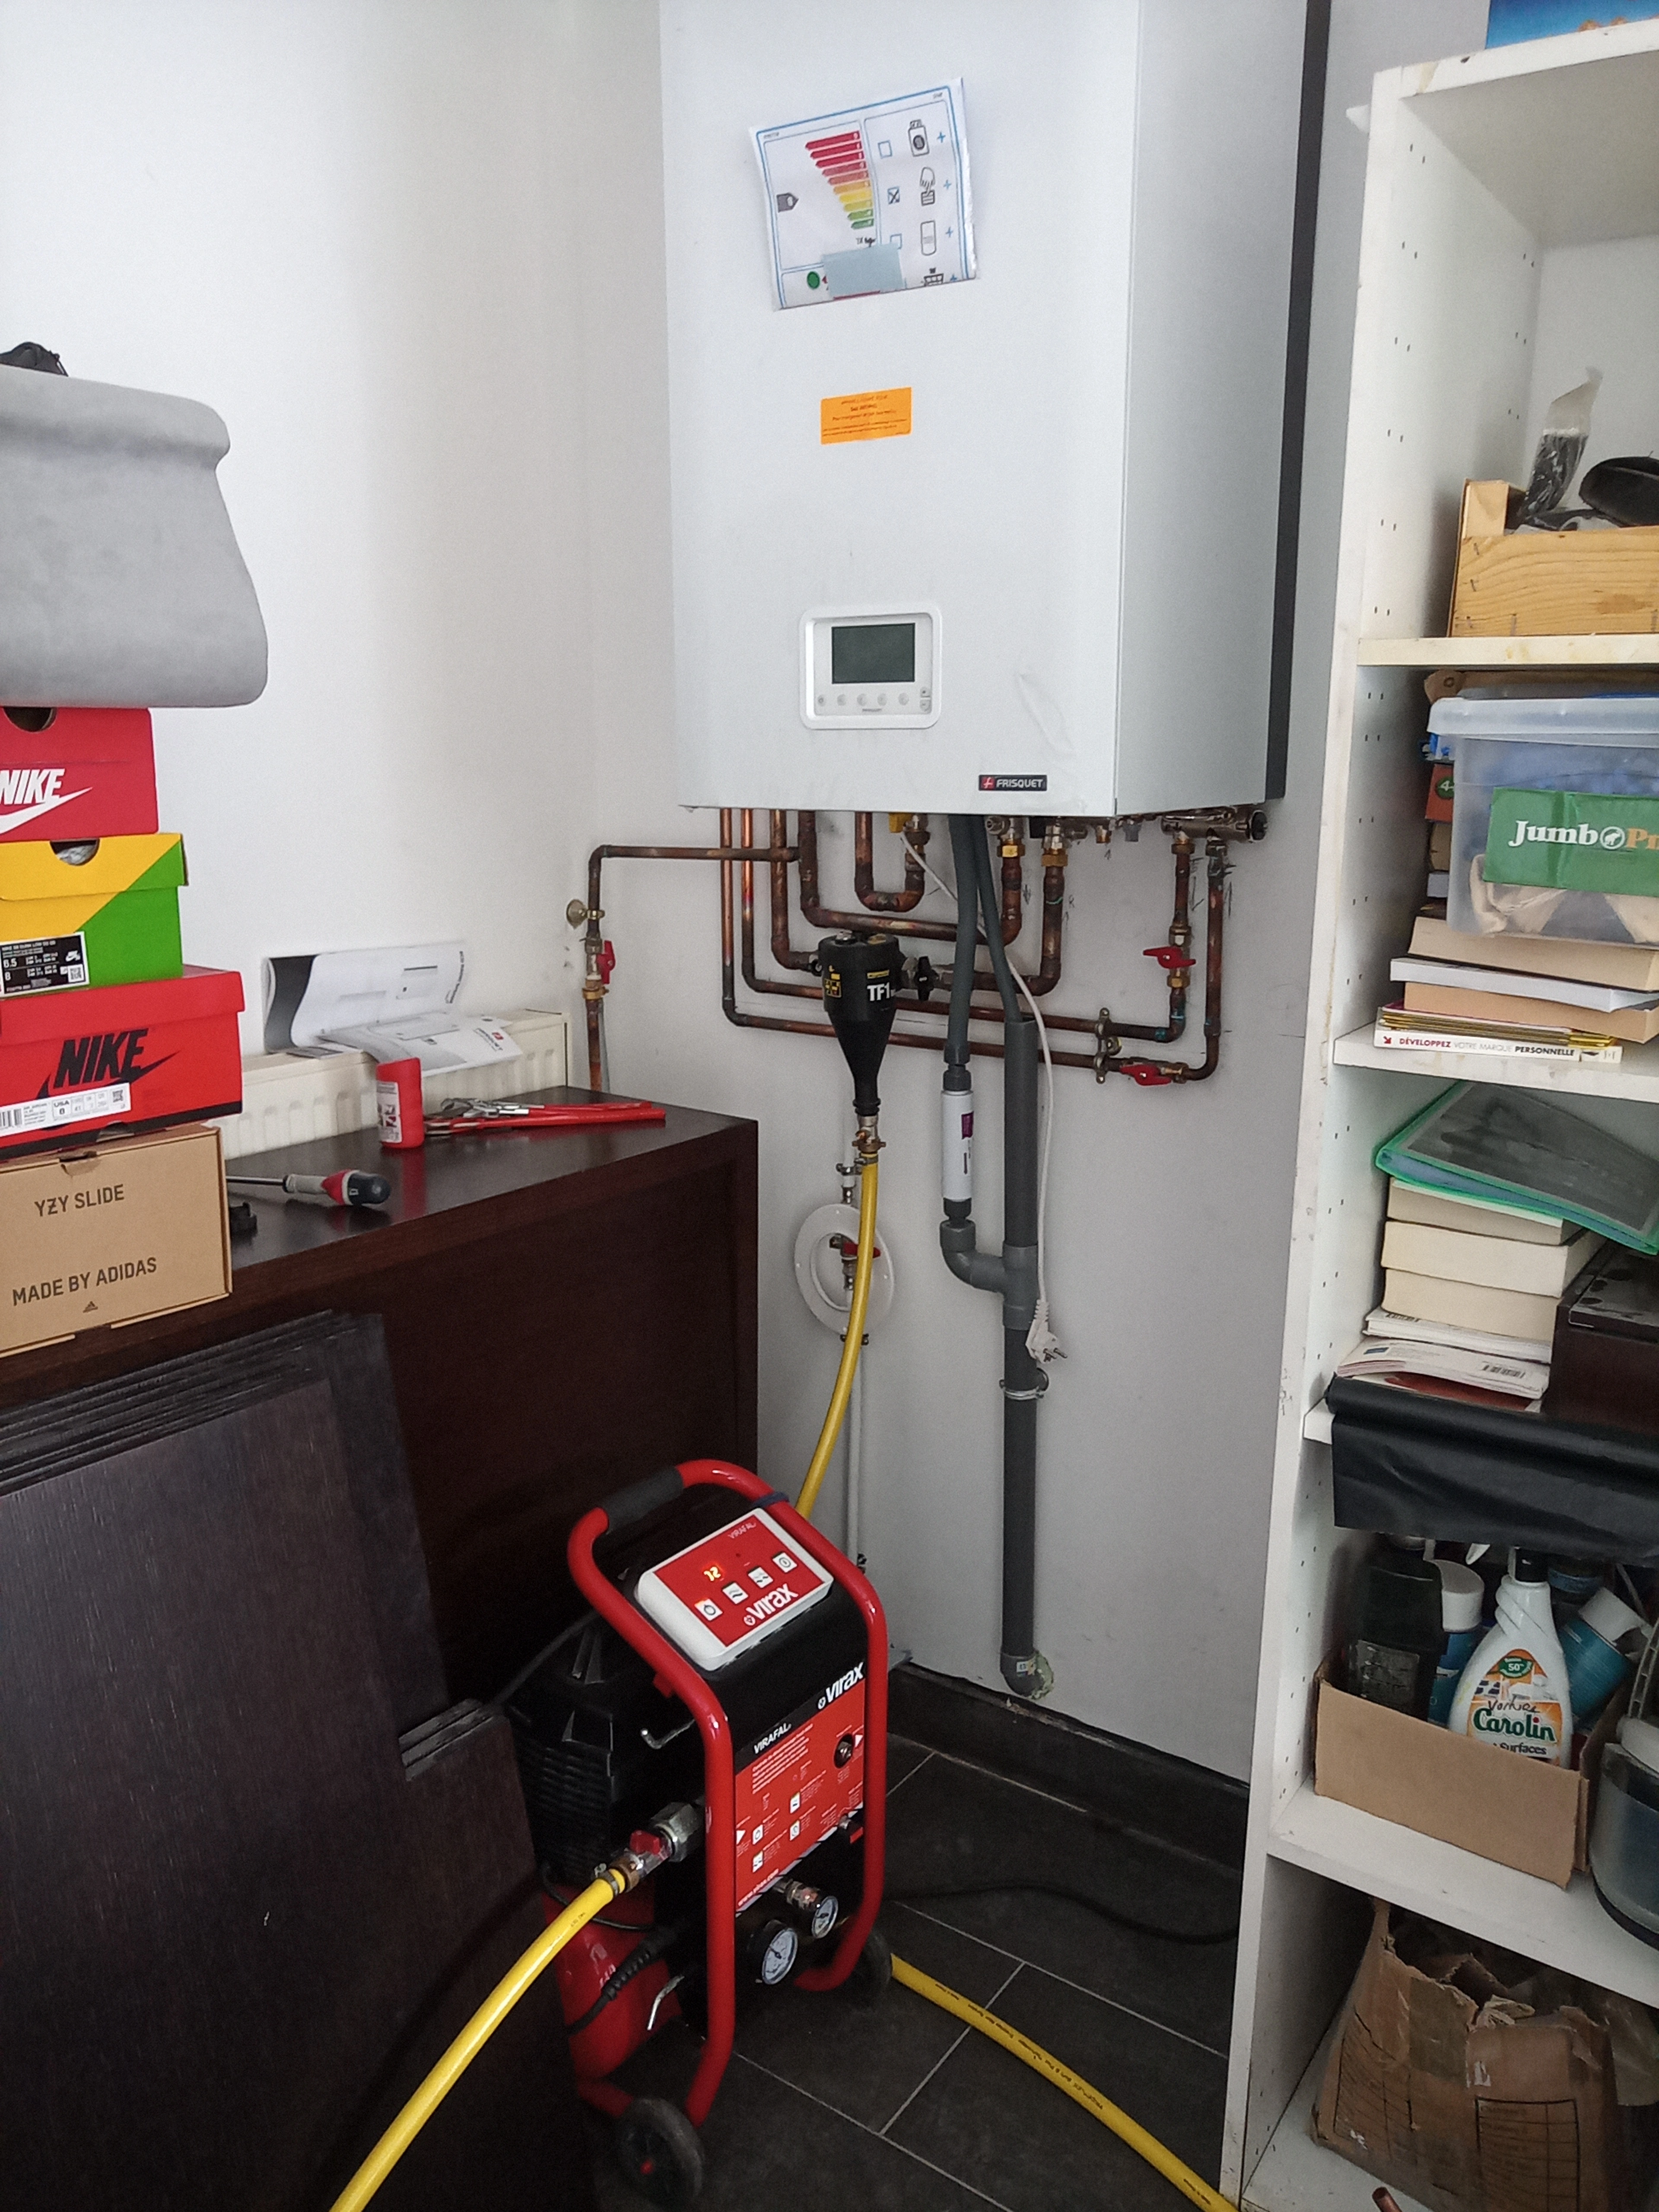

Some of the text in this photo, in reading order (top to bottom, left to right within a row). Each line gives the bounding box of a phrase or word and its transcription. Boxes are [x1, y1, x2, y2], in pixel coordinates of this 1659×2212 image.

[0, 768, 65, 804] NIKE
[996, 779, 1043, 788] FRISQUET
[867, 982, 890, 1001] TF1
[54, 1028, 149, 1089] NIKE
[1399, 1037, 1451, 1048] DÉVELOPPEZ
[1515, 1046, 1575, 1056] PERSONNELLE
[34, 1184, 124, 1217] YZY SLIDE
[13, 1257, 156, 1306] MADE BY ADIDAS
[753, 1723, 788, 1754] VIRAFAL
[1473, 1708, 1555, 1742] Carolin
